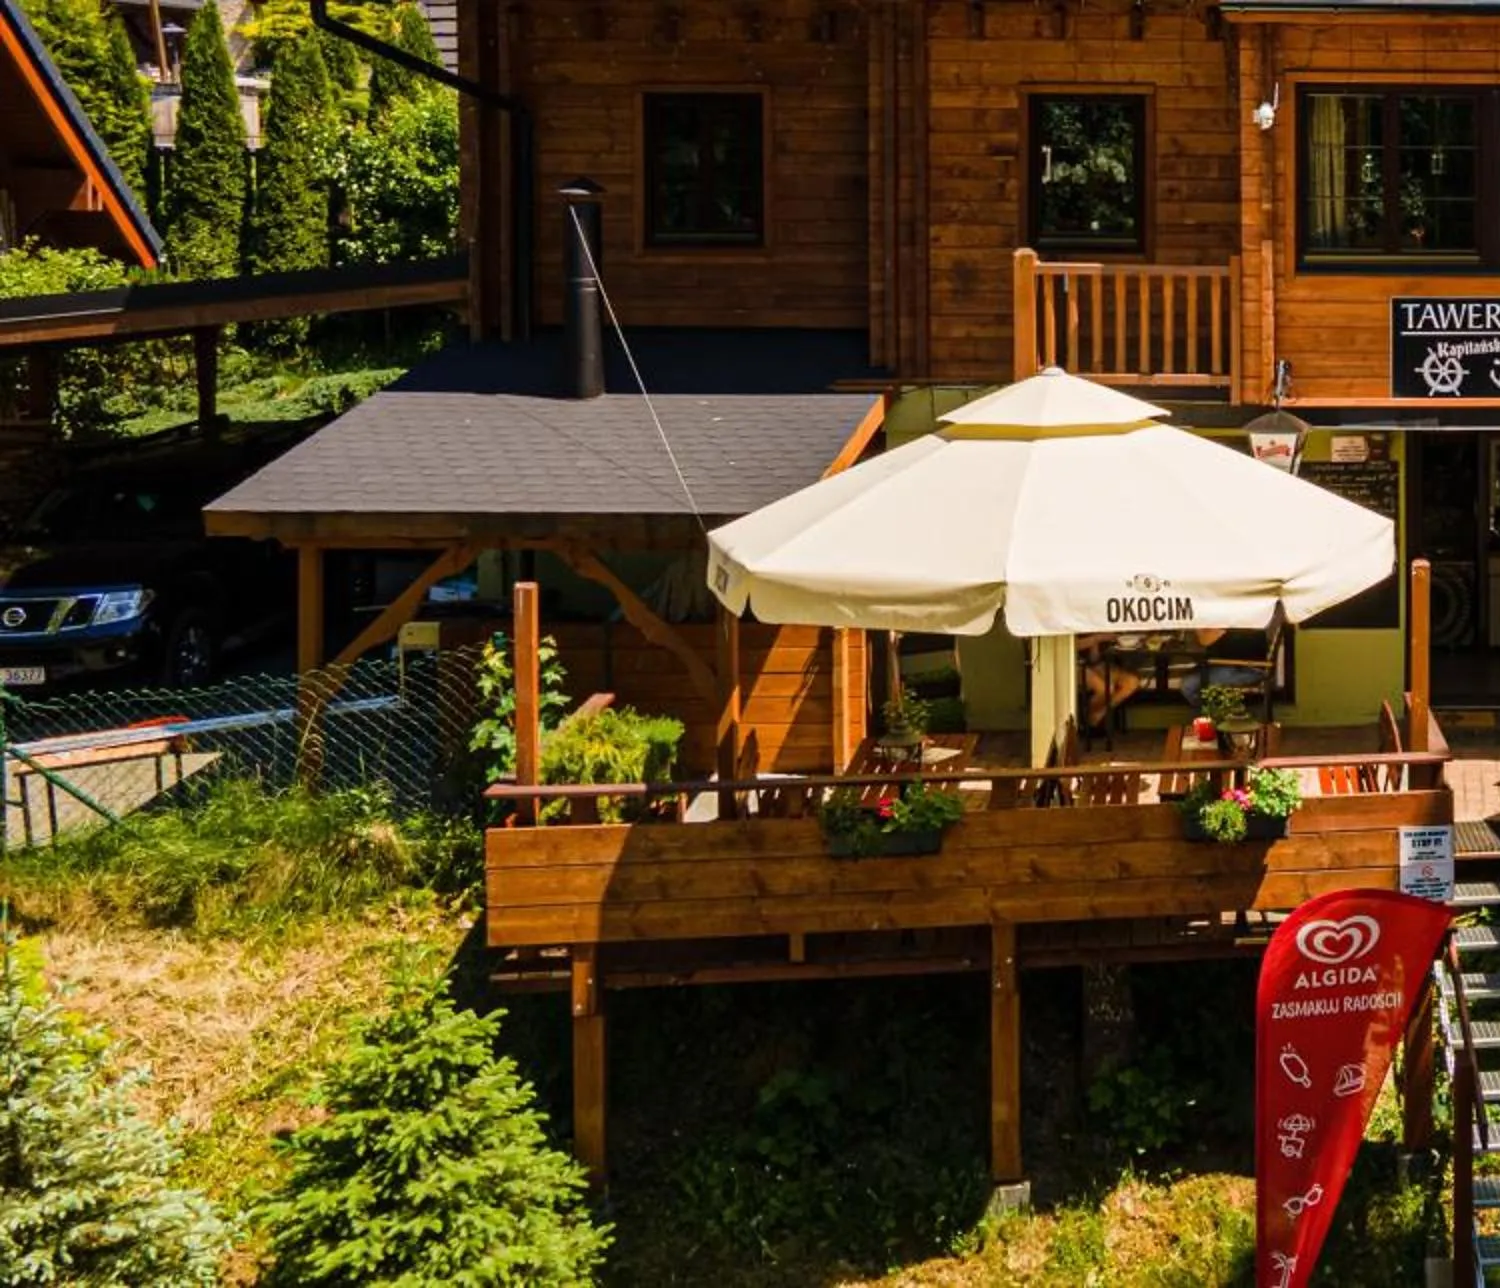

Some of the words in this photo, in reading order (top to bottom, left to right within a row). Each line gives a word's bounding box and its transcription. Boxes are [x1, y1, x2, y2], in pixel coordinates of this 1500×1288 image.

[1106, 596, 1193, 623] OKOCIM
[1294, 966, 1378, 990] ALGIDA
[1271, 998, 1340, 1019] ZASMAKUJ
